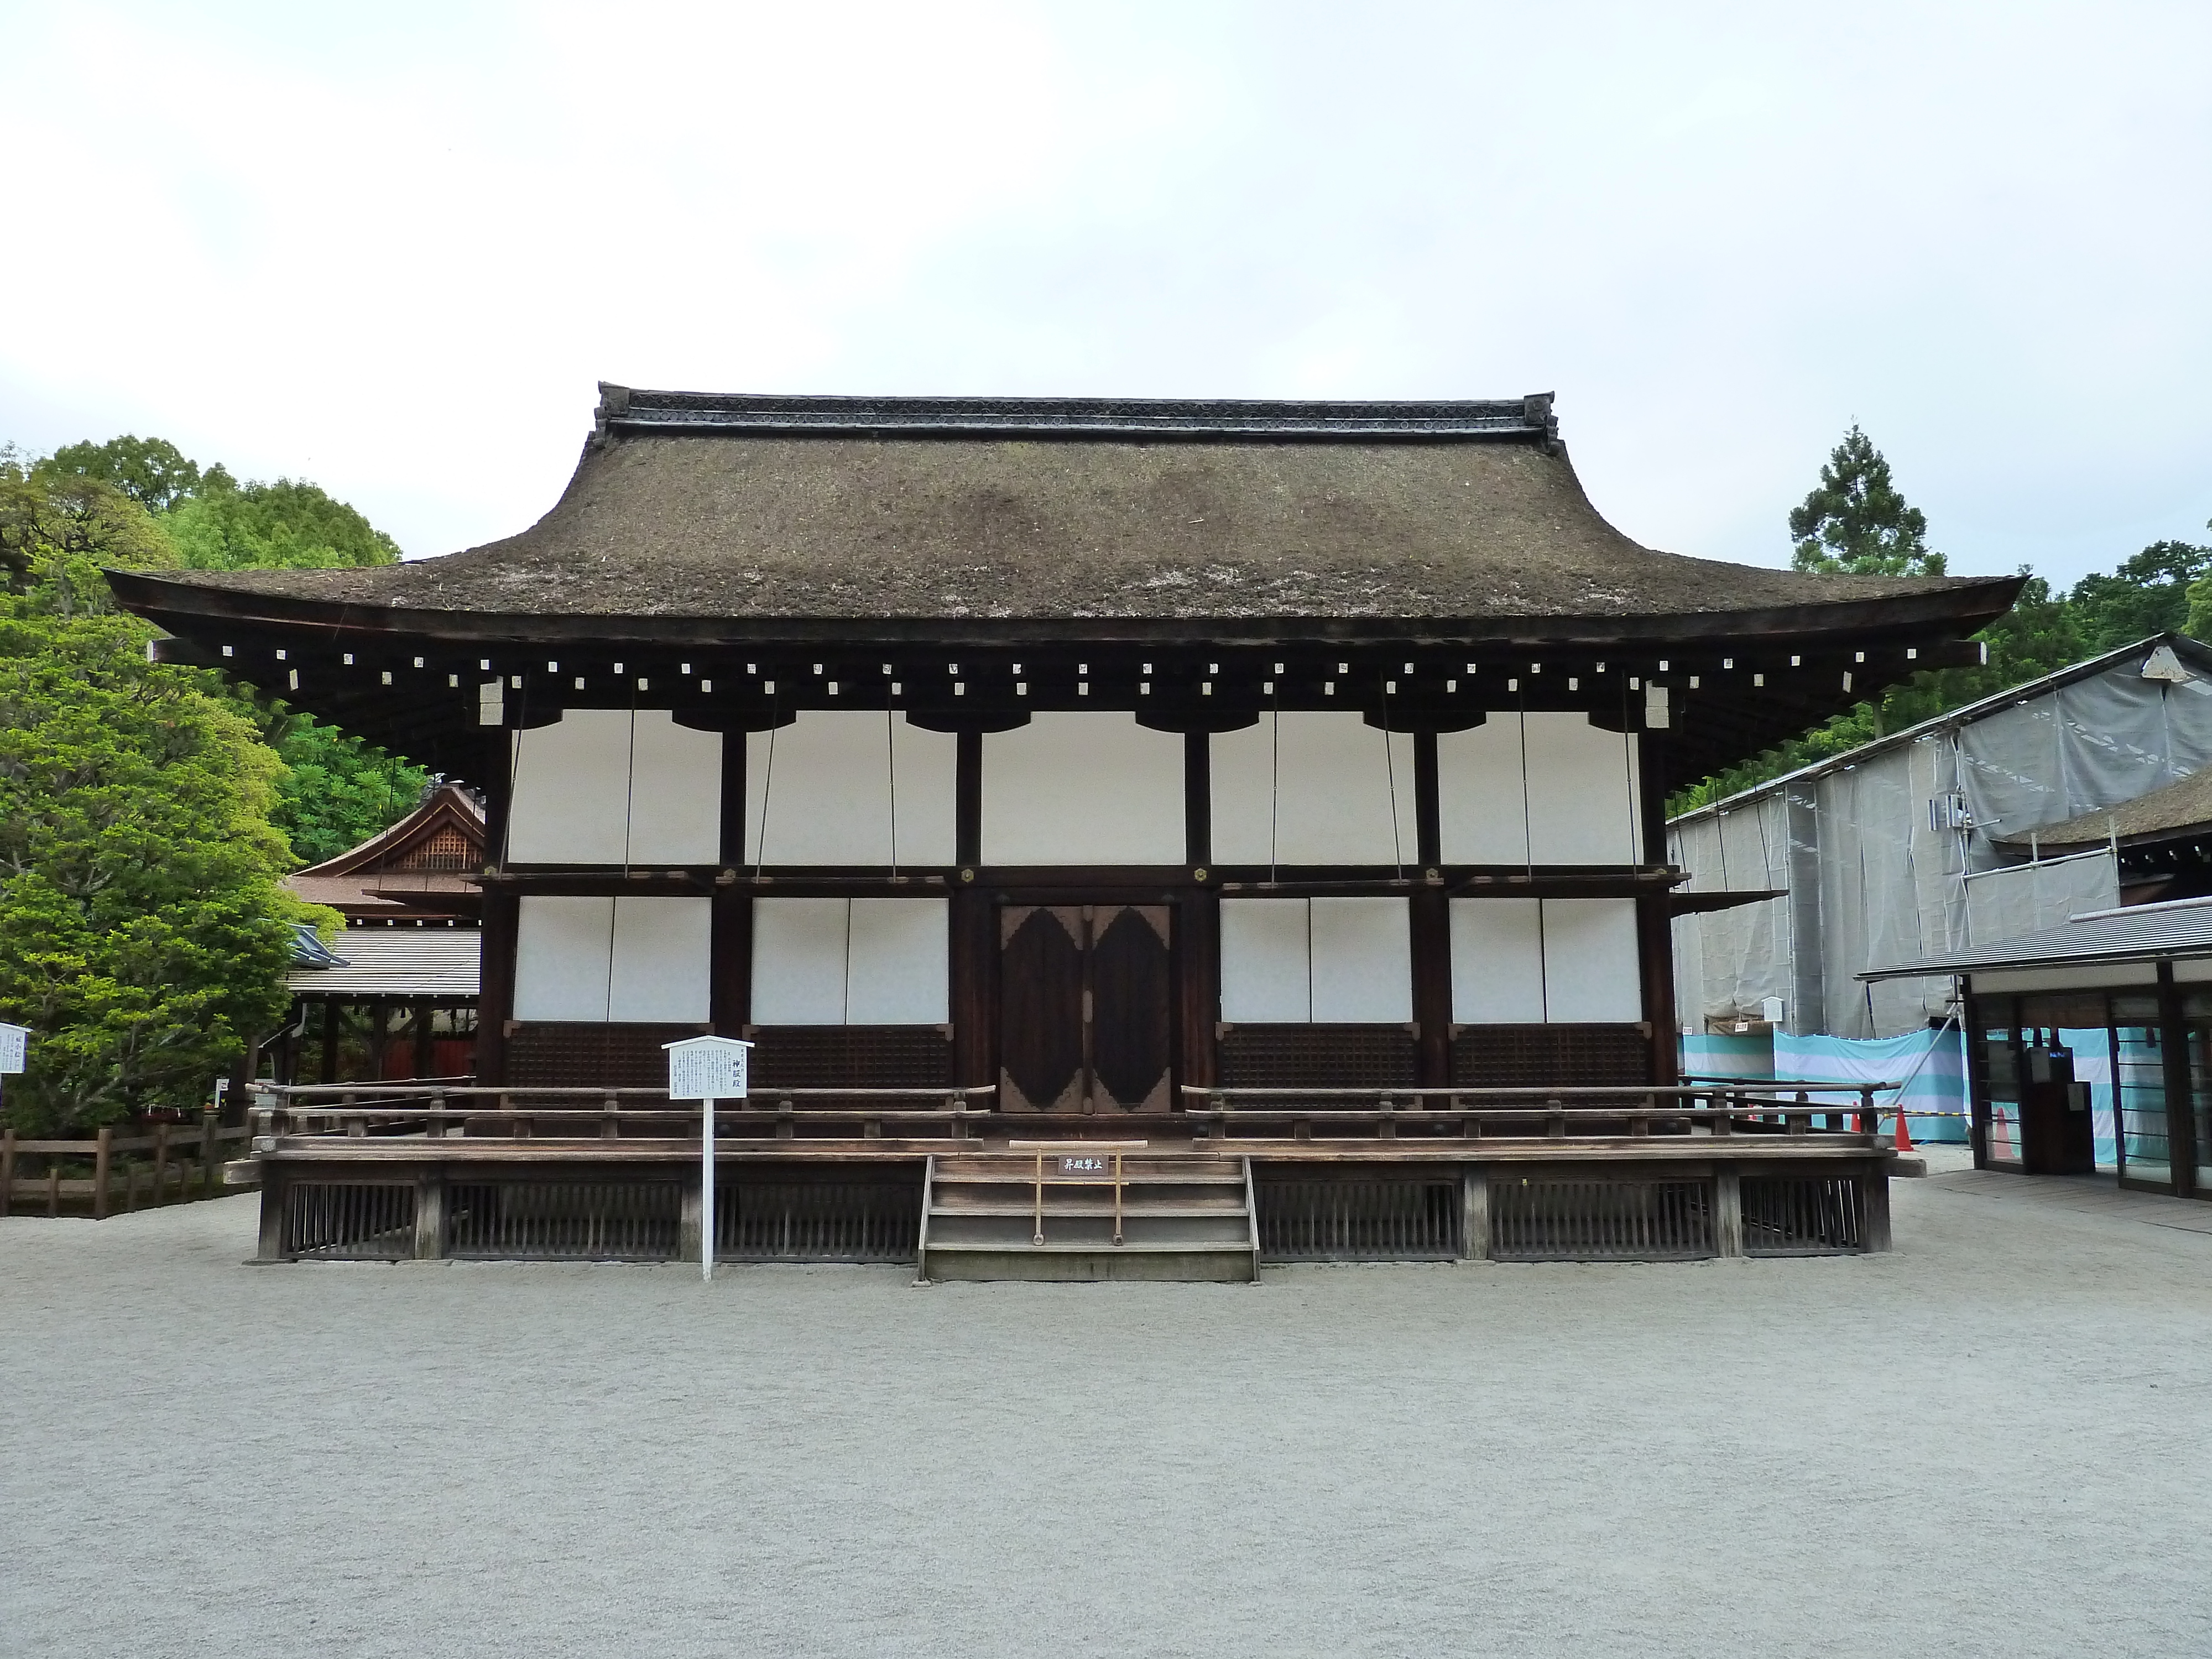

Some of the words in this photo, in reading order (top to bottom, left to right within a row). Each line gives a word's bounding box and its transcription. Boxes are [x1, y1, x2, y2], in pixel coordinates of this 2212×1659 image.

[733, 1060, 741, 1087] 神服殿
[1064, 1158, 1103, 1171] 昇殿禁止
